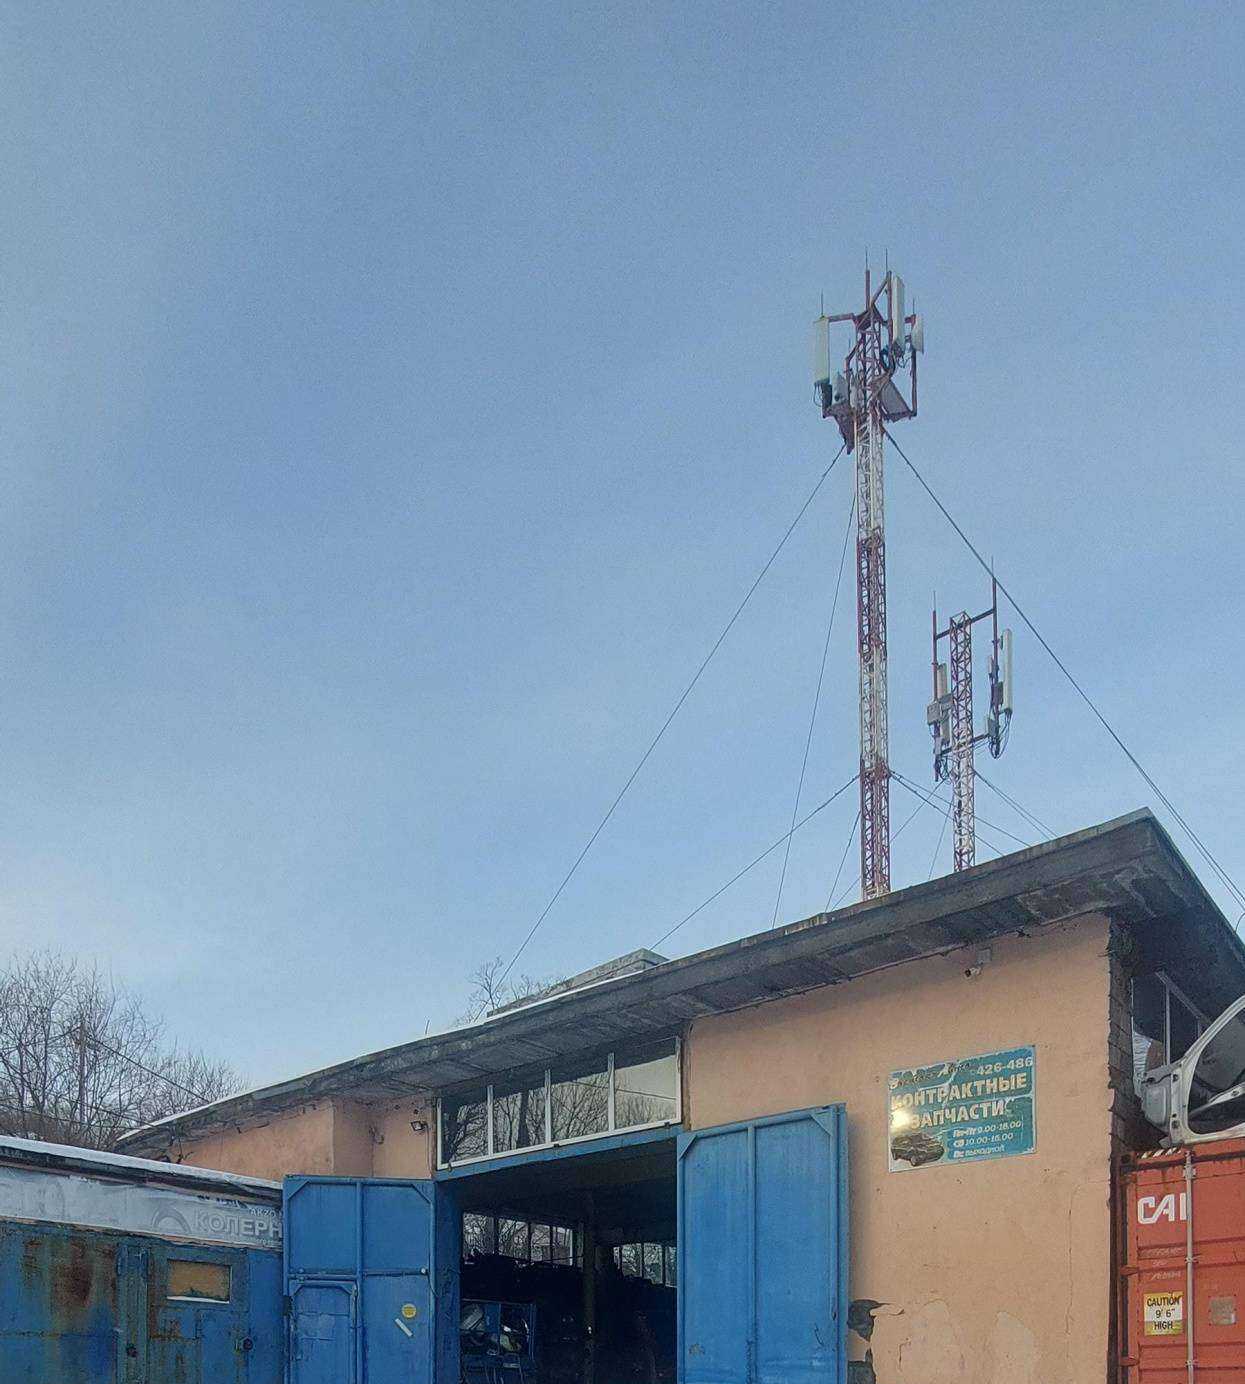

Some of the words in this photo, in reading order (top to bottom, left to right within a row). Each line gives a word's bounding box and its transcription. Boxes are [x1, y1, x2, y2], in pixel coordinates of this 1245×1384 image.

[976, 1056, 1034, 1076] 426-486
[890, 1071, 1028, 1110] КОНТРАКТНЫЕ
[1137, 1192, 1188, 1225] CAI
[1146, 1294, 1181, 1308] CAUTION
[1153, 1320, 1173, 1331] HIGH
